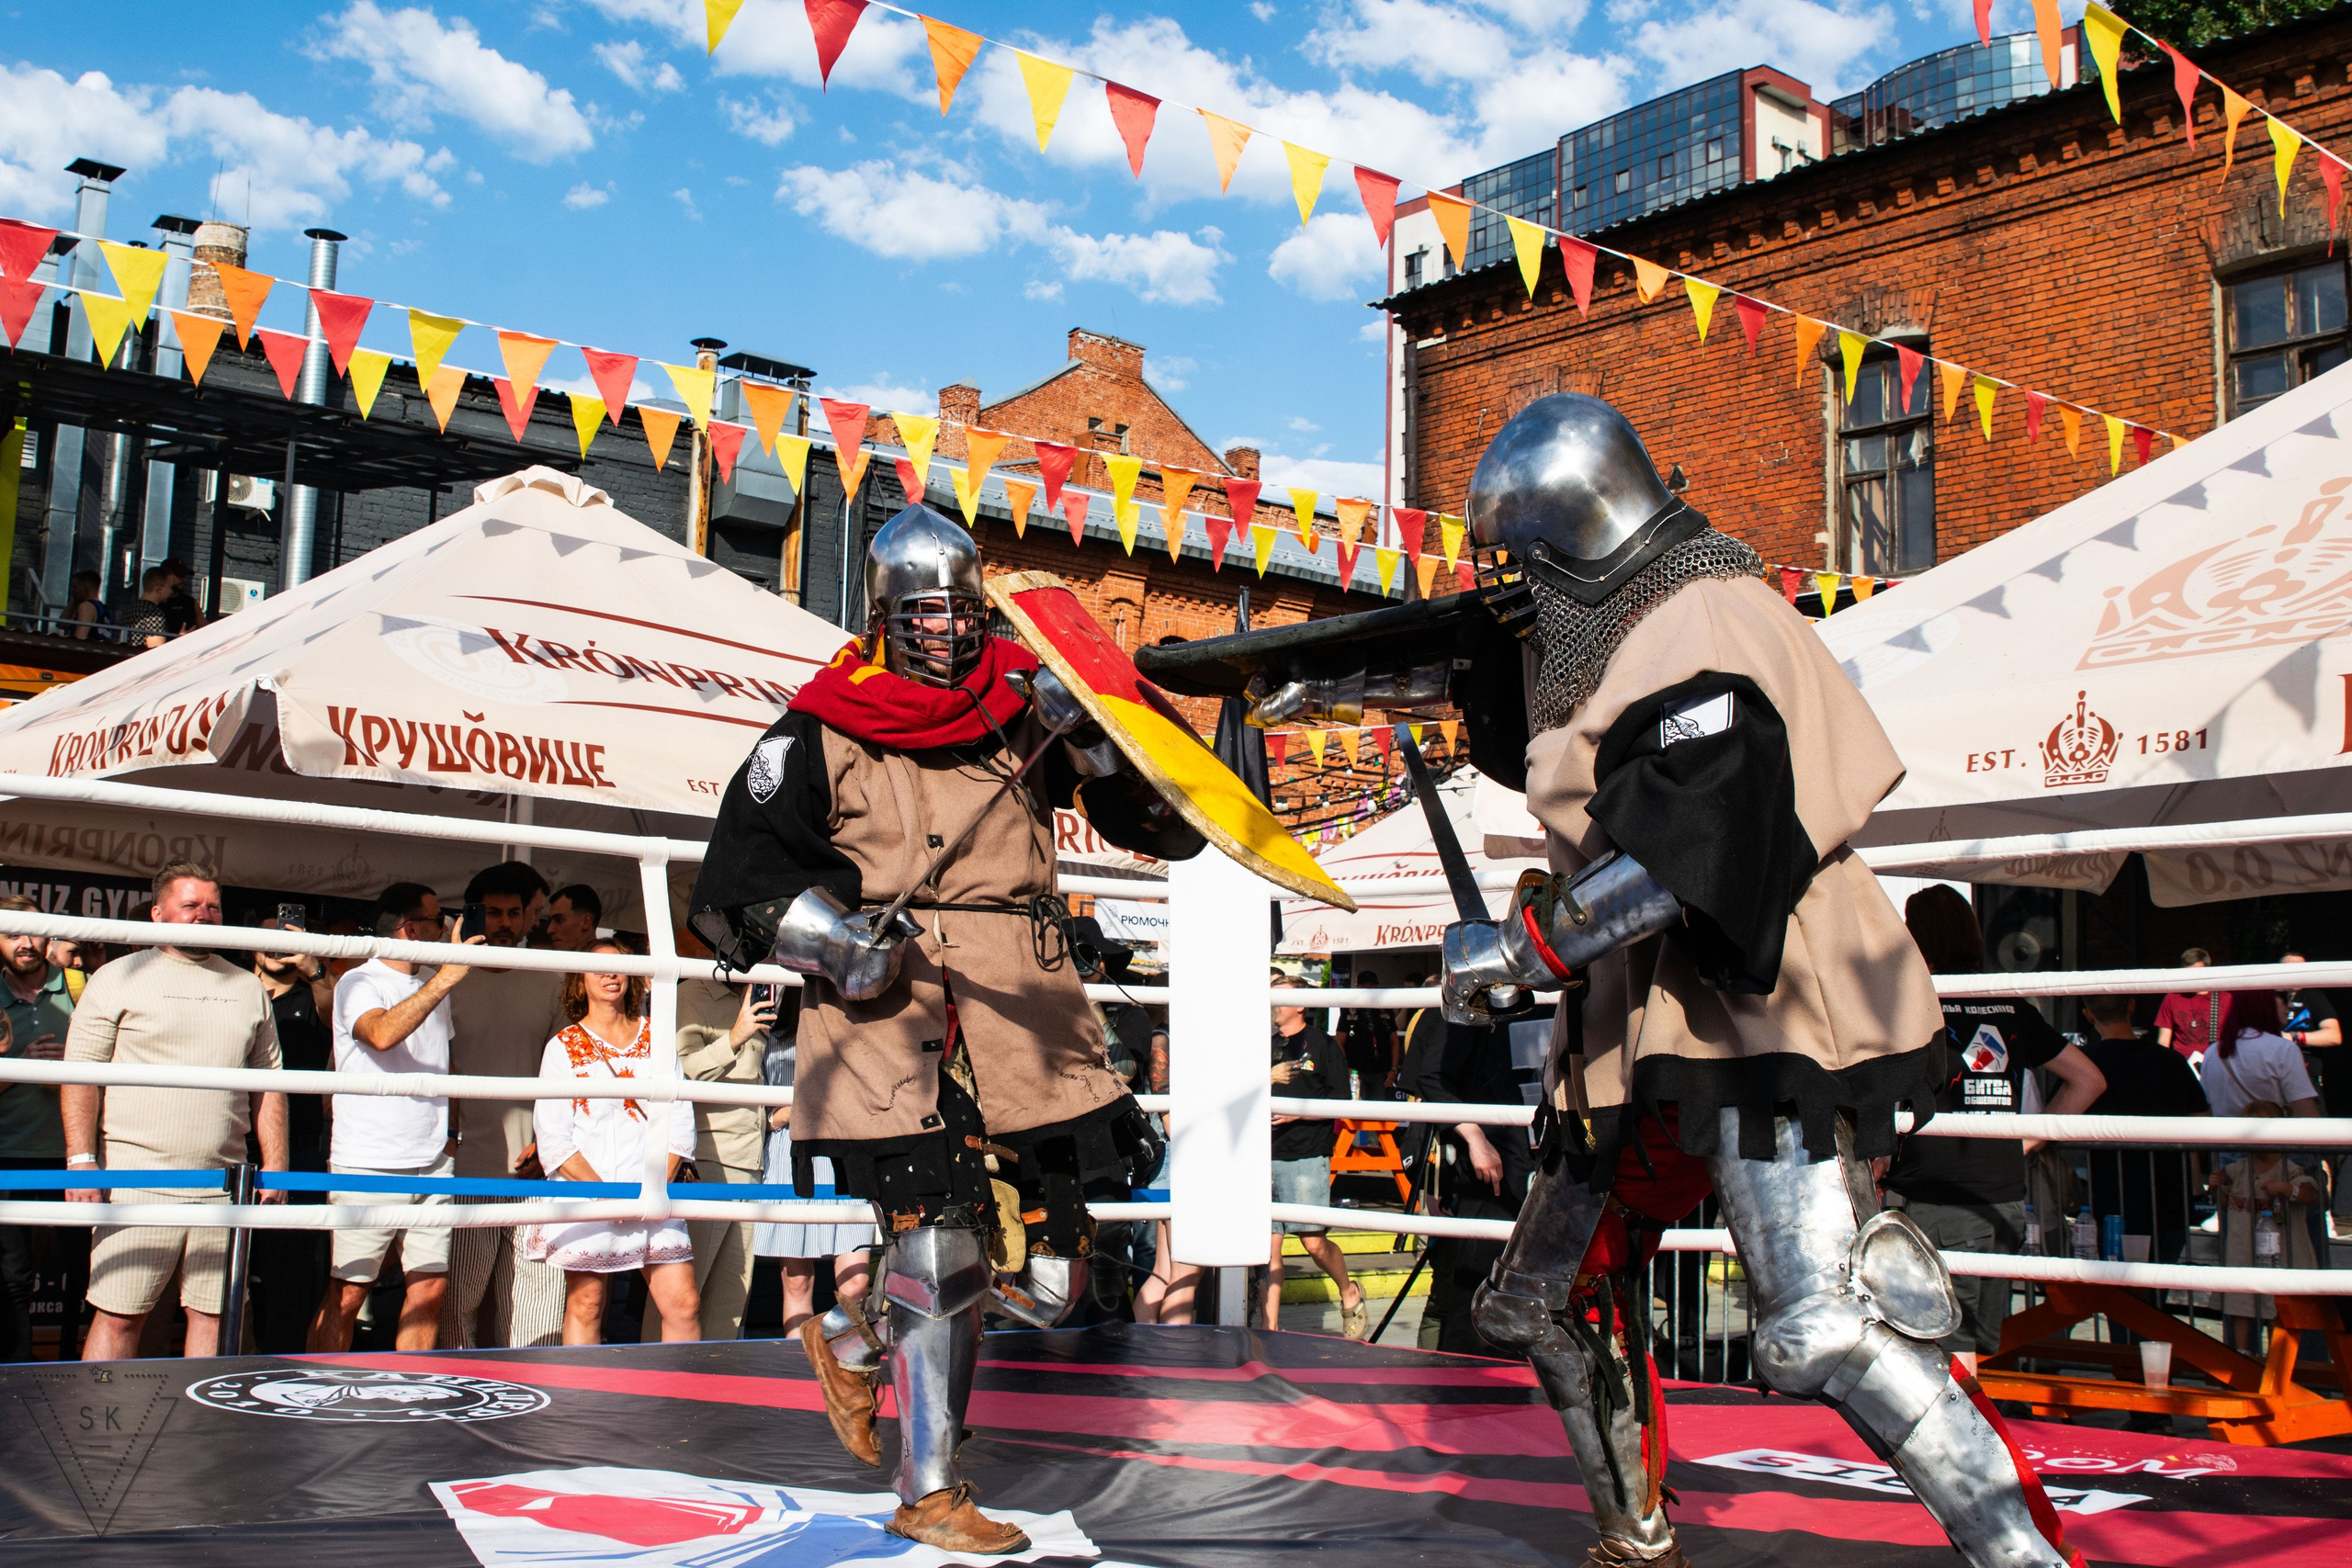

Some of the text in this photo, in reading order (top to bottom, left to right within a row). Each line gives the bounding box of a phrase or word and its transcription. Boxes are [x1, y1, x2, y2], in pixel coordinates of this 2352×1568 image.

[1966, 728, 2208, 773] EST. 1581
[1963, 1078, 2012, 1096] БИТВА
